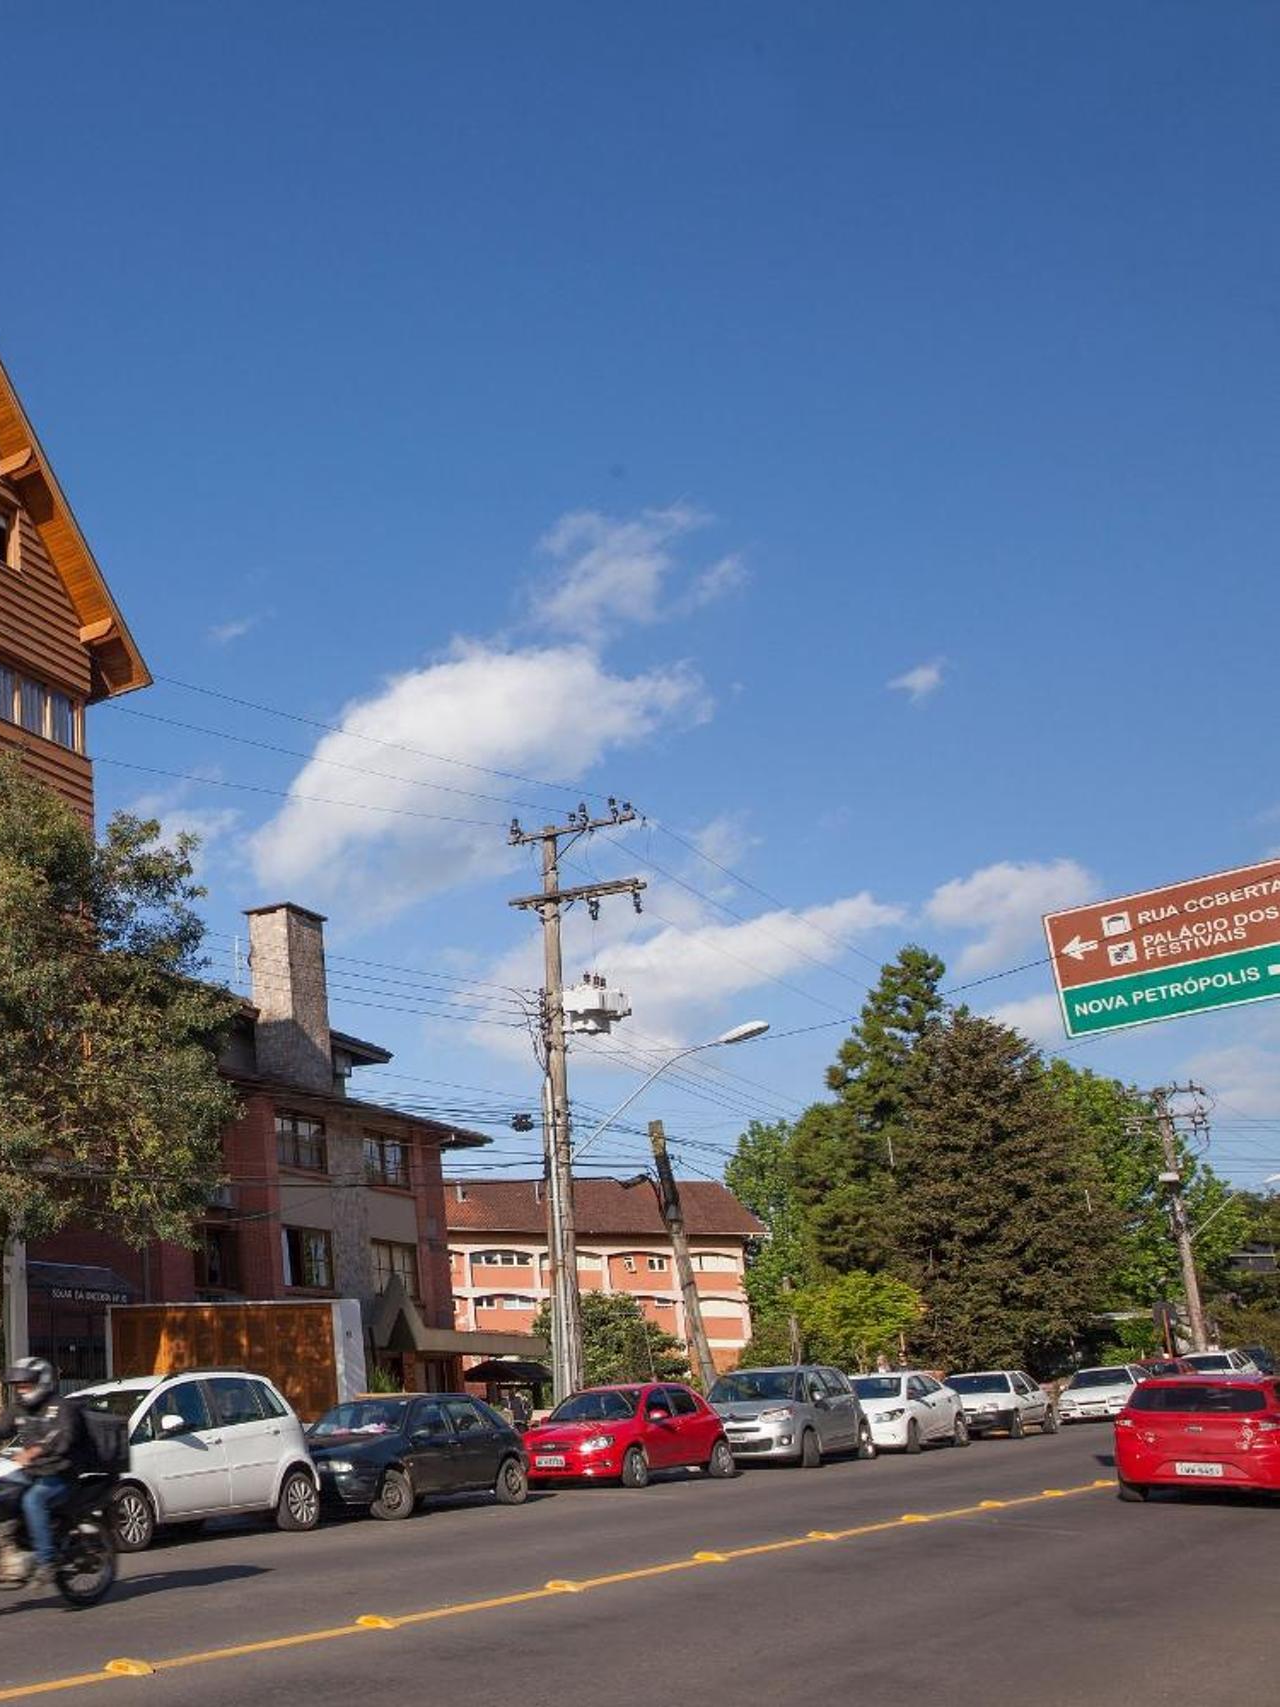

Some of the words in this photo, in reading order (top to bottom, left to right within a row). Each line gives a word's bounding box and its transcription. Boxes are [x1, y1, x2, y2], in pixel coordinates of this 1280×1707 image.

[1138, 904, 1180, 924] RUA
[1233, 905, 1279, 927] DOS
[1144, 927, 1247, 960] FESTIVAIS
[1074, 994, 1129, 1017] NOVA
[1132, 967, 1261, 1005] PETRÓPOLIS
